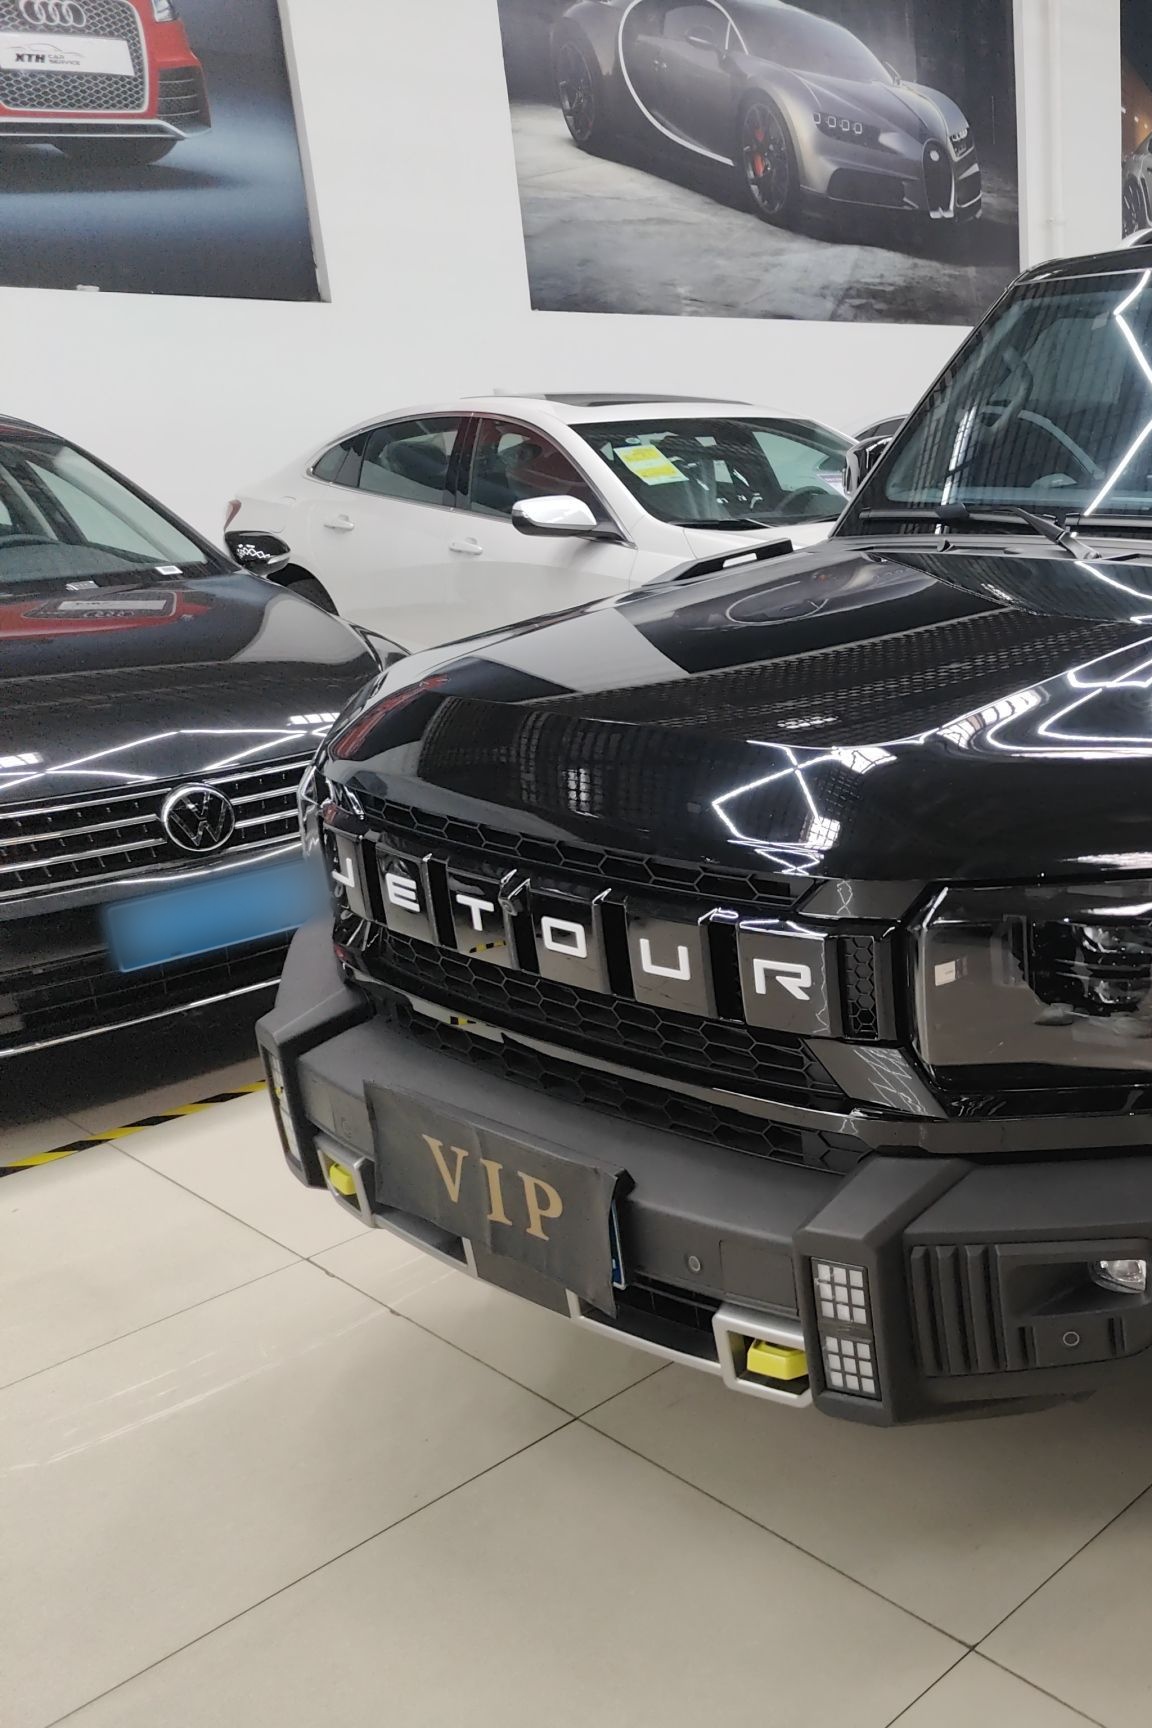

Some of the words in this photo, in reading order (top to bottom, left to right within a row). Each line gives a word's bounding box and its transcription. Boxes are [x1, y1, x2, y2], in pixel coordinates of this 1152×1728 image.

[15, 52, 46, 64] XTH
[331, 857, 813, 1001] JETOUR
[421, 1133, 564, 1242] VIP
